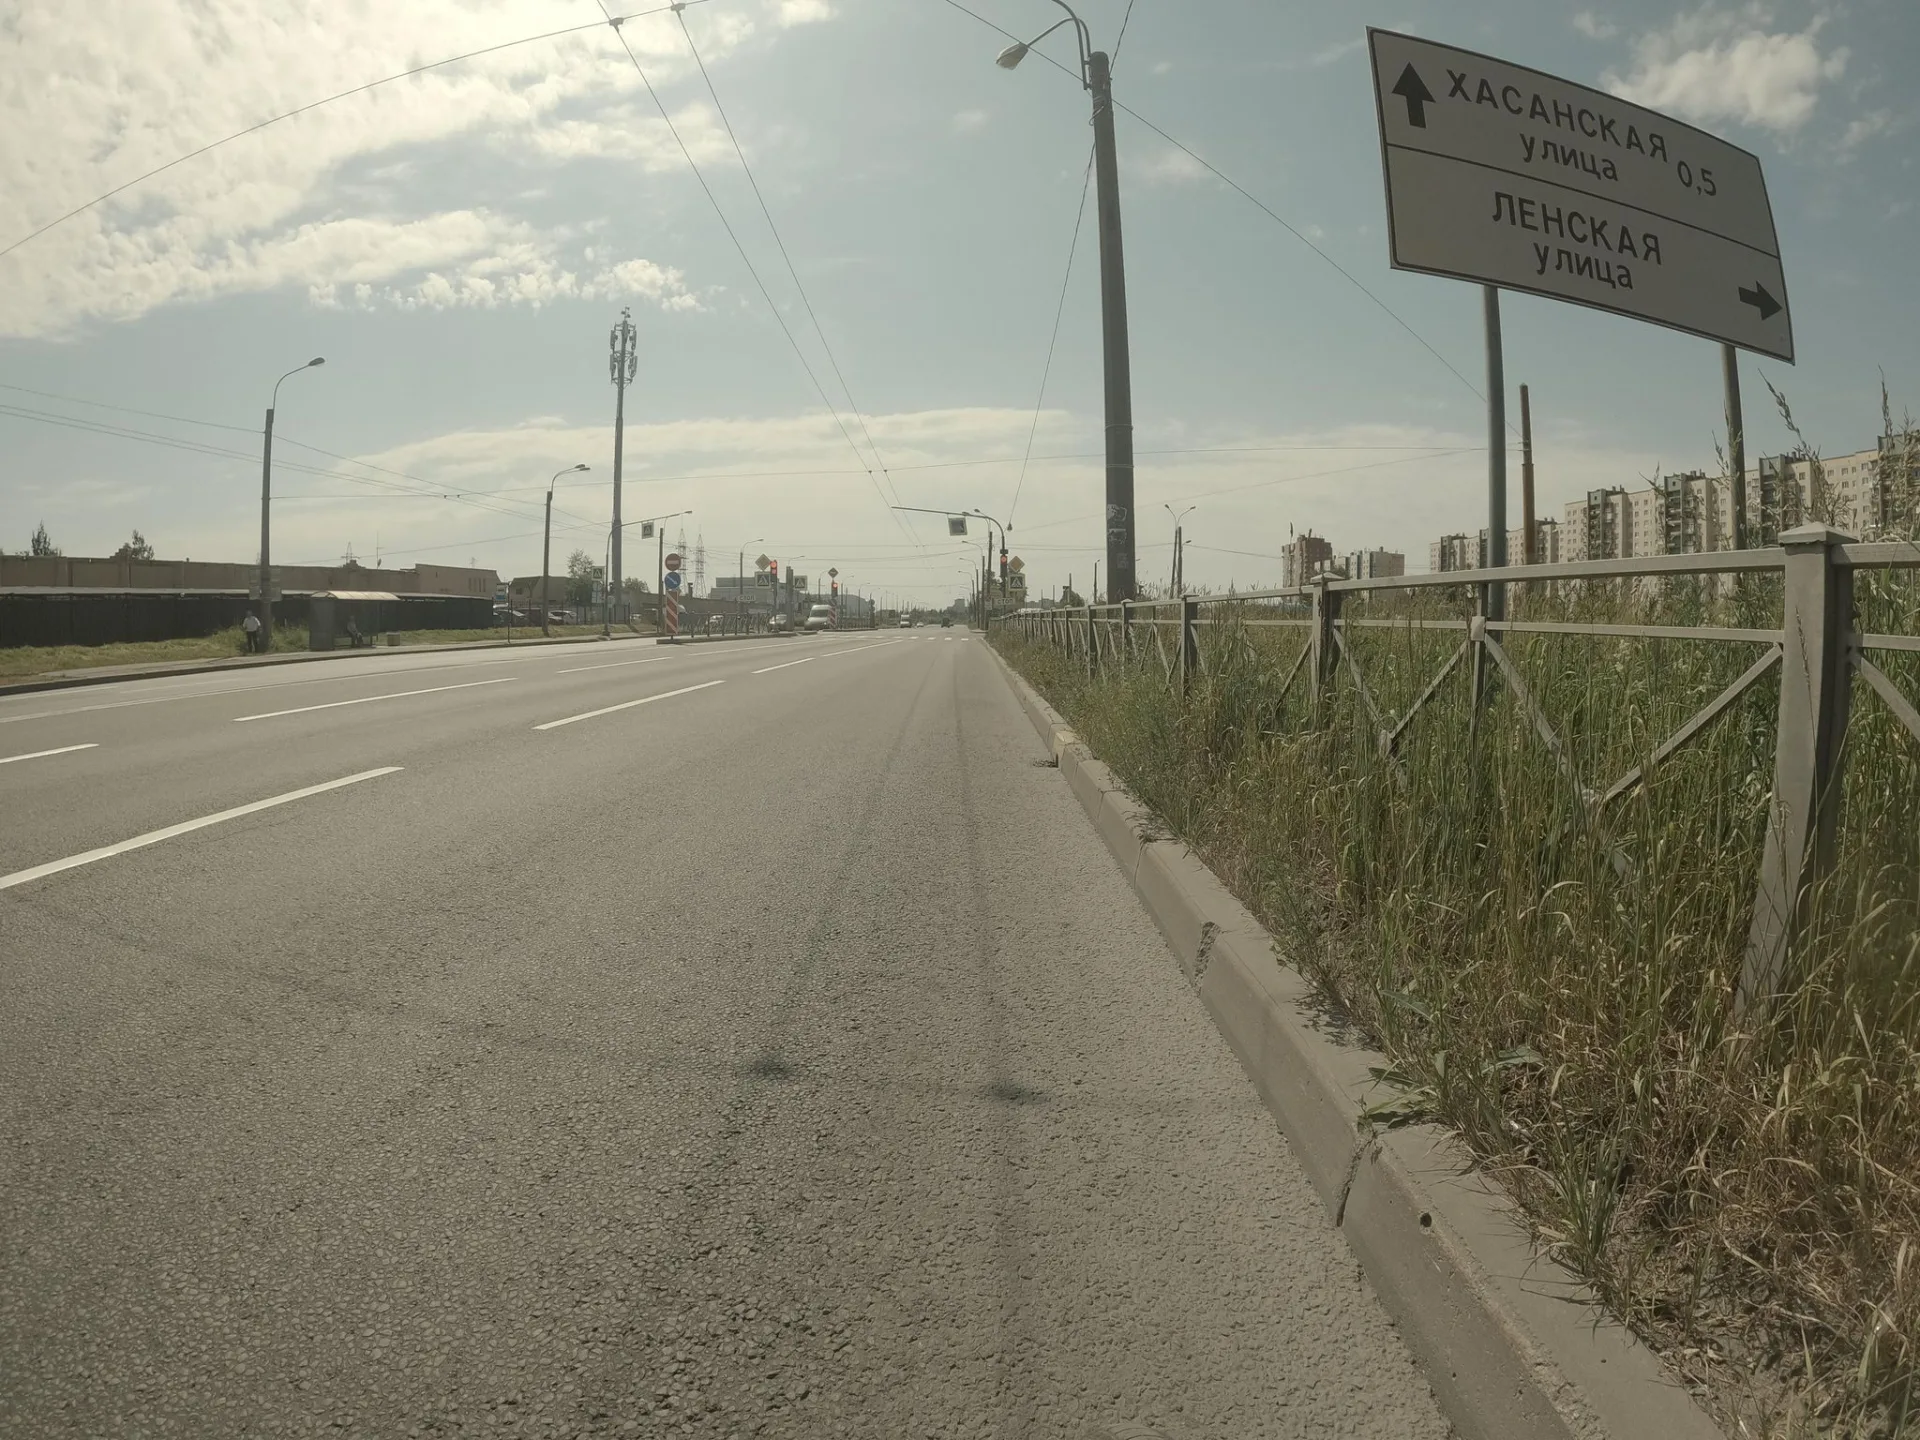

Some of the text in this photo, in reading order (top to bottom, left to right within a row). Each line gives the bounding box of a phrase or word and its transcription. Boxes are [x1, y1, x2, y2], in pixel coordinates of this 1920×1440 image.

[1446, 68, 1668, 163] ХАСАНСКАЯ
[1519, 133, 1618, 181] улица
[1677, 160, 1717, 197] 0,5
[1492, 191, 1663, 265] ЛЕНСКАЯ
[1533, 242, 1634, 290] улица
